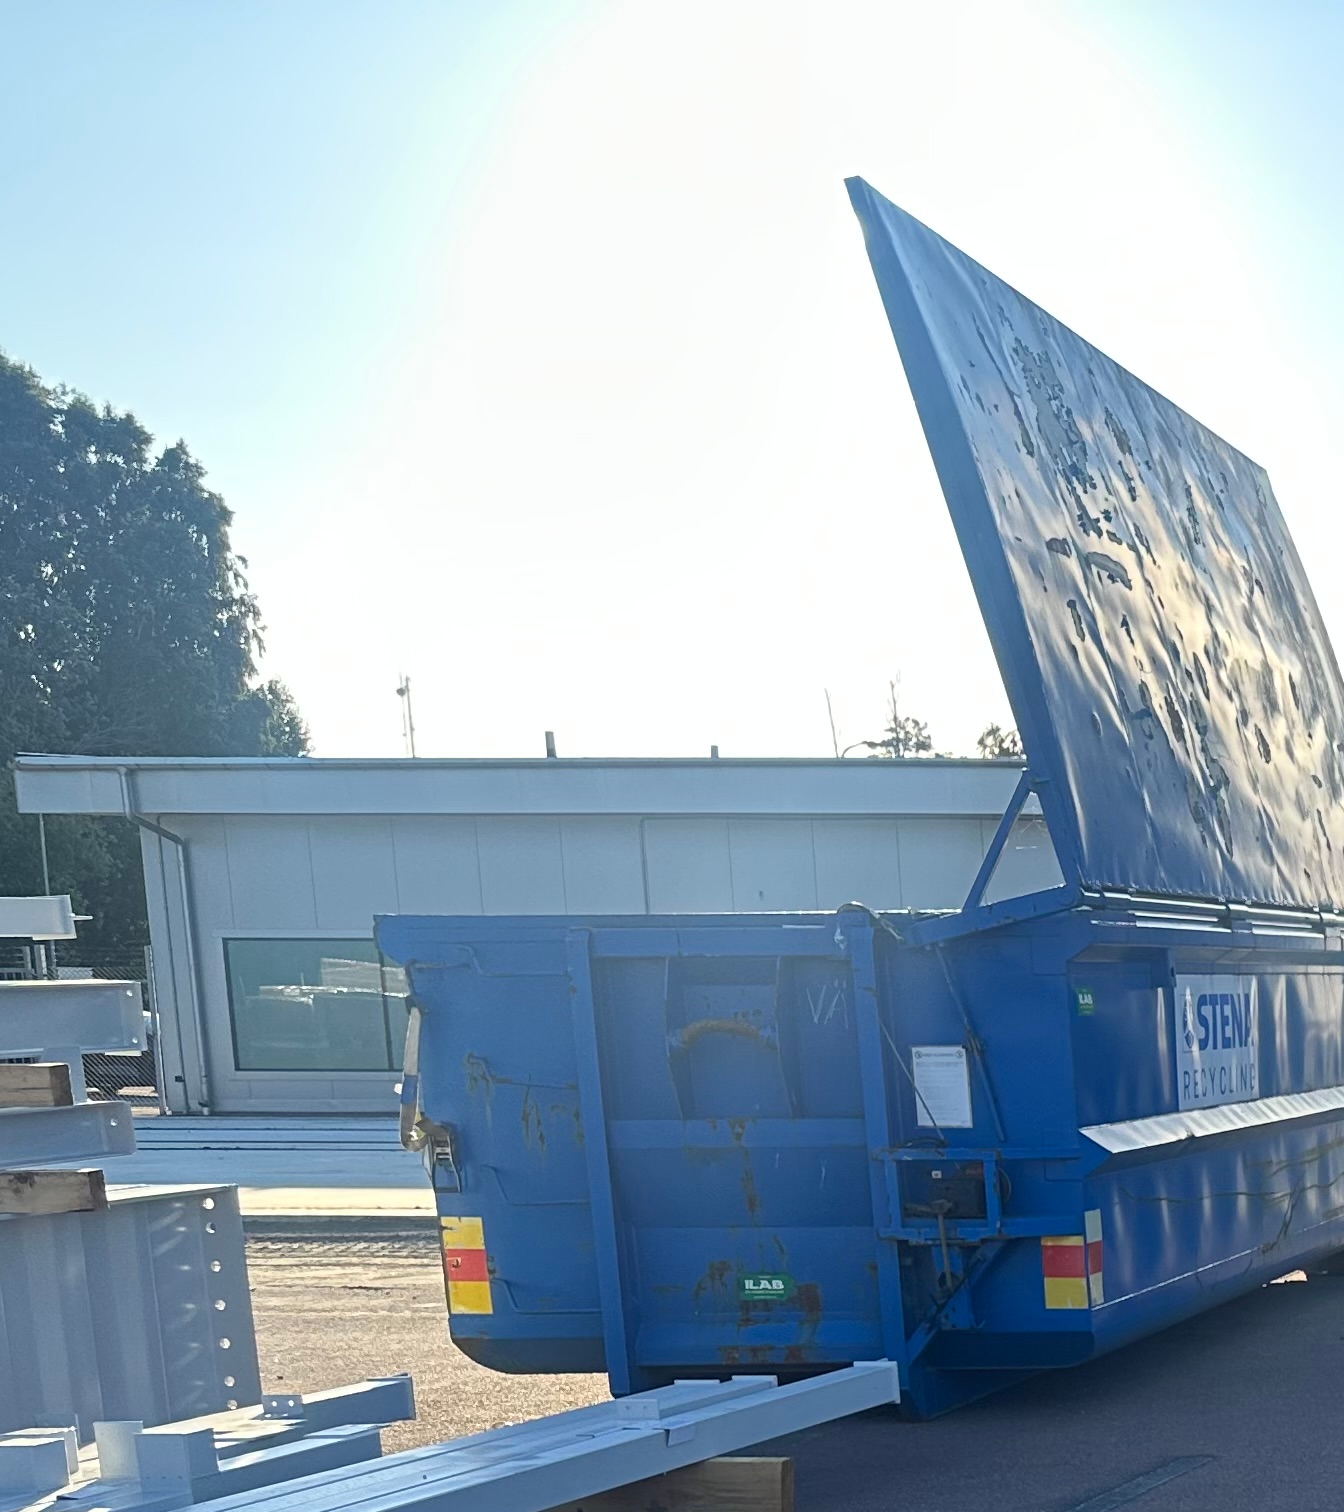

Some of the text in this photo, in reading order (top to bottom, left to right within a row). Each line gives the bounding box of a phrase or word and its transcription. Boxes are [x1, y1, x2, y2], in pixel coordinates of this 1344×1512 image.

[1197, 993, 1255, 1051] STENA
[1183, 1064, 1256, 1101] RECYCLING
[744, 1279, 785, 1290] ILAB
